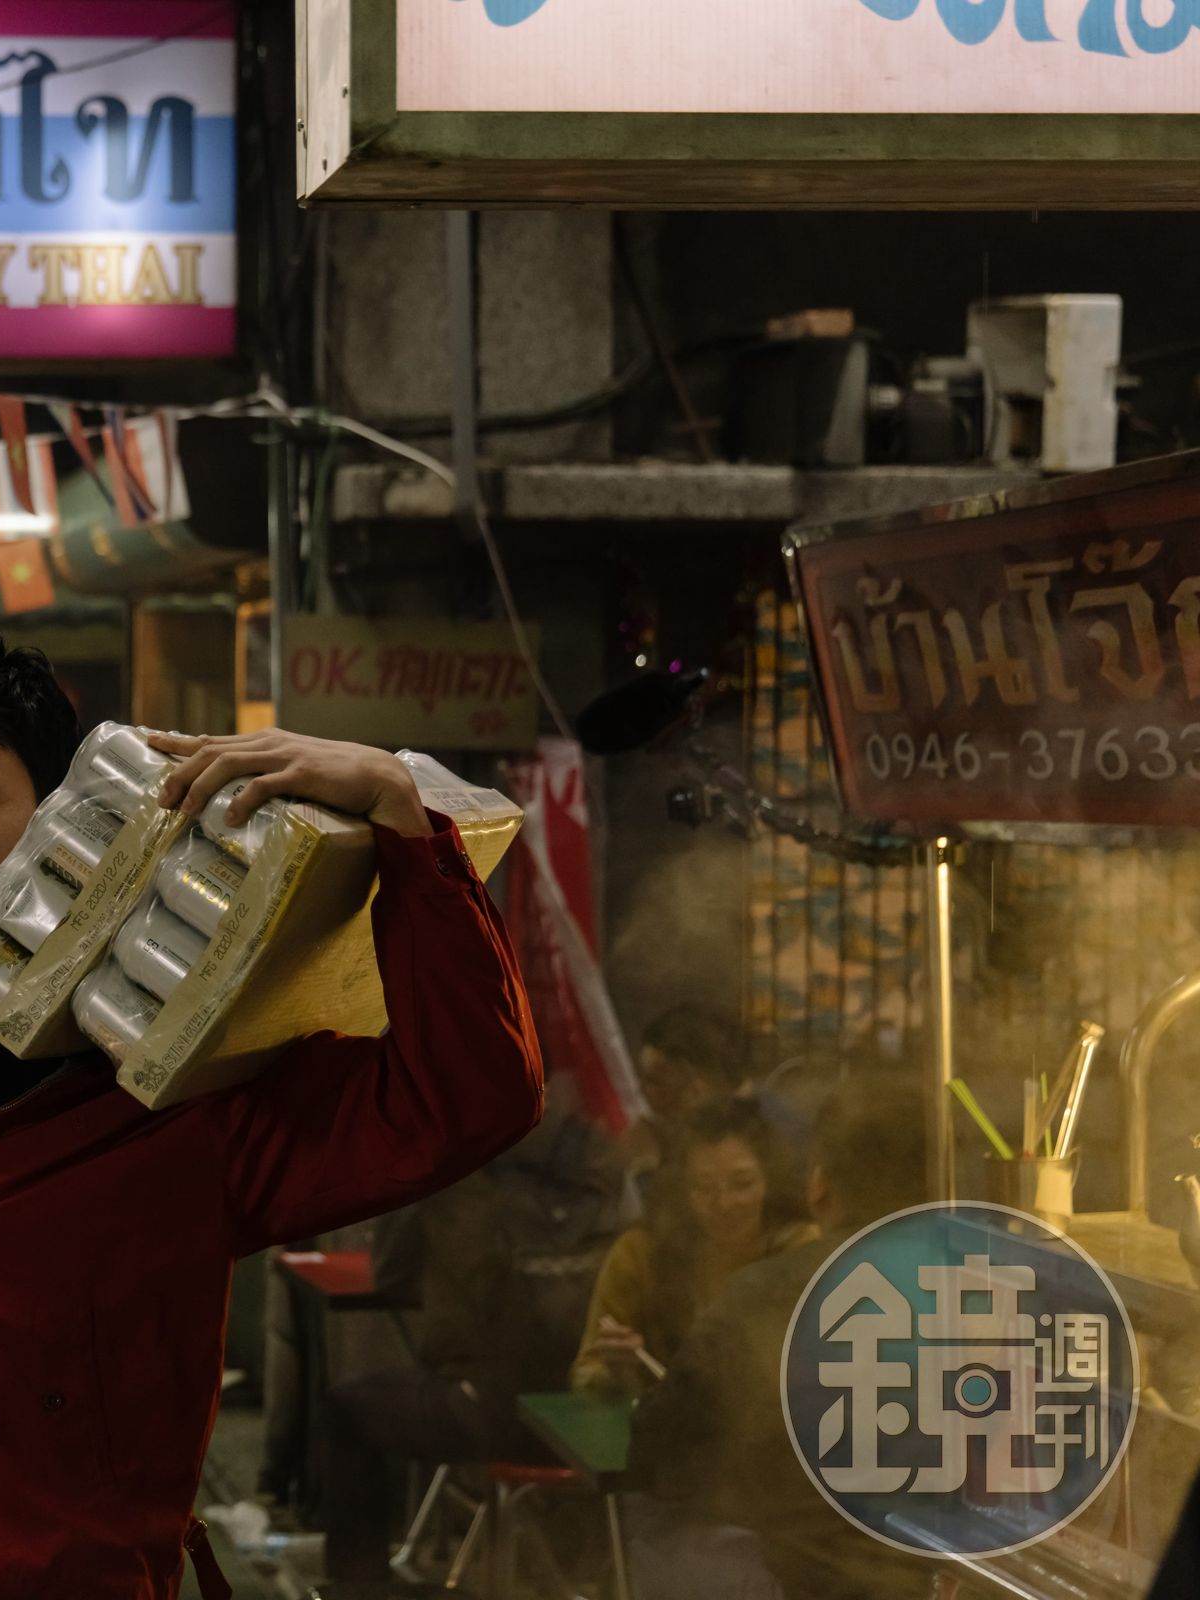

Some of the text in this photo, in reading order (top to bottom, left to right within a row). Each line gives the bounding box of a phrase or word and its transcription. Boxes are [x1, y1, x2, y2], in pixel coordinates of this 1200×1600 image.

[29, 243, 205, 306] THAI
[70, 910, 90, 933] MFG
[87, 851, 129, 910] 2020/12/22
[28, 956, 76, 1021] SINGHA
[199, 960, 218, 982] MFG
[161, 1005, 213, 1072] SINGHA
